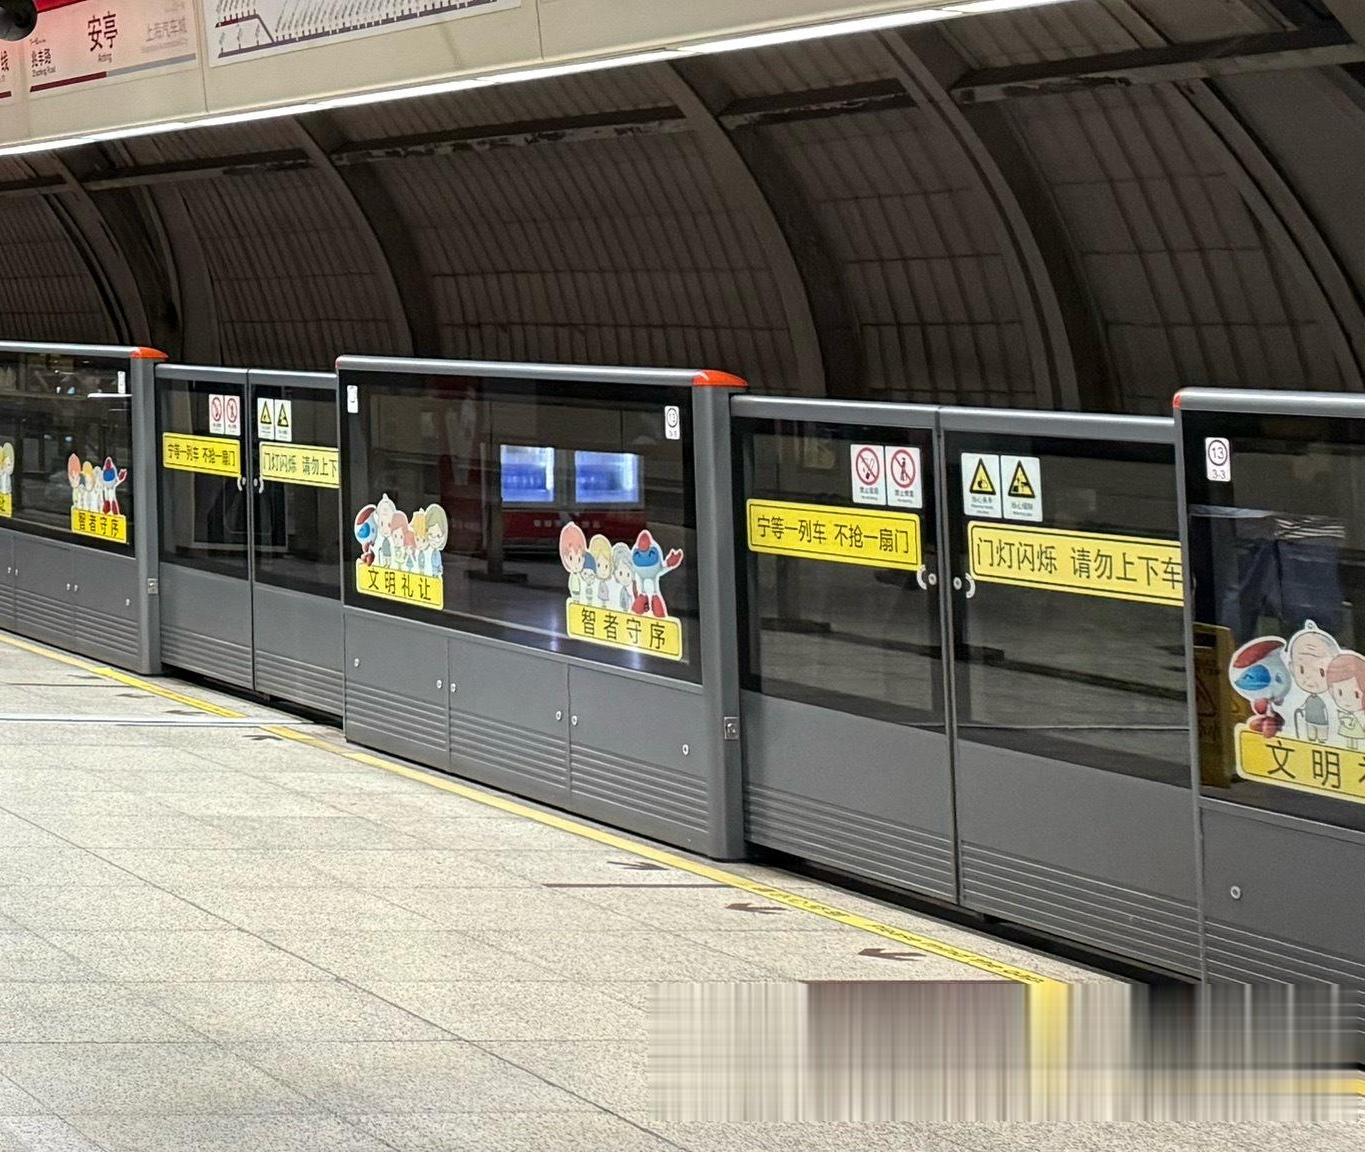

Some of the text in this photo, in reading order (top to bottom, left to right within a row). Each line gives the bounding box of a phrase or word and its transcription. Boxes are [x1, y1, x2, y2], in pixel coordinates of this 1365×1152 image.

[87, 11, 118, 51] 安亭
[1211, 447, 1225, 460] 13
[757, 515, 909, 554] 宁等一列车 不抢一扇门
[976, 537, 1184, 591] 门灯闪烁 请勿上下车
[367, 569, 432, 601] 文明礼让
[581, 607, 666, 650] 智者守序
[1265, 740, 1365, 789] 文明
